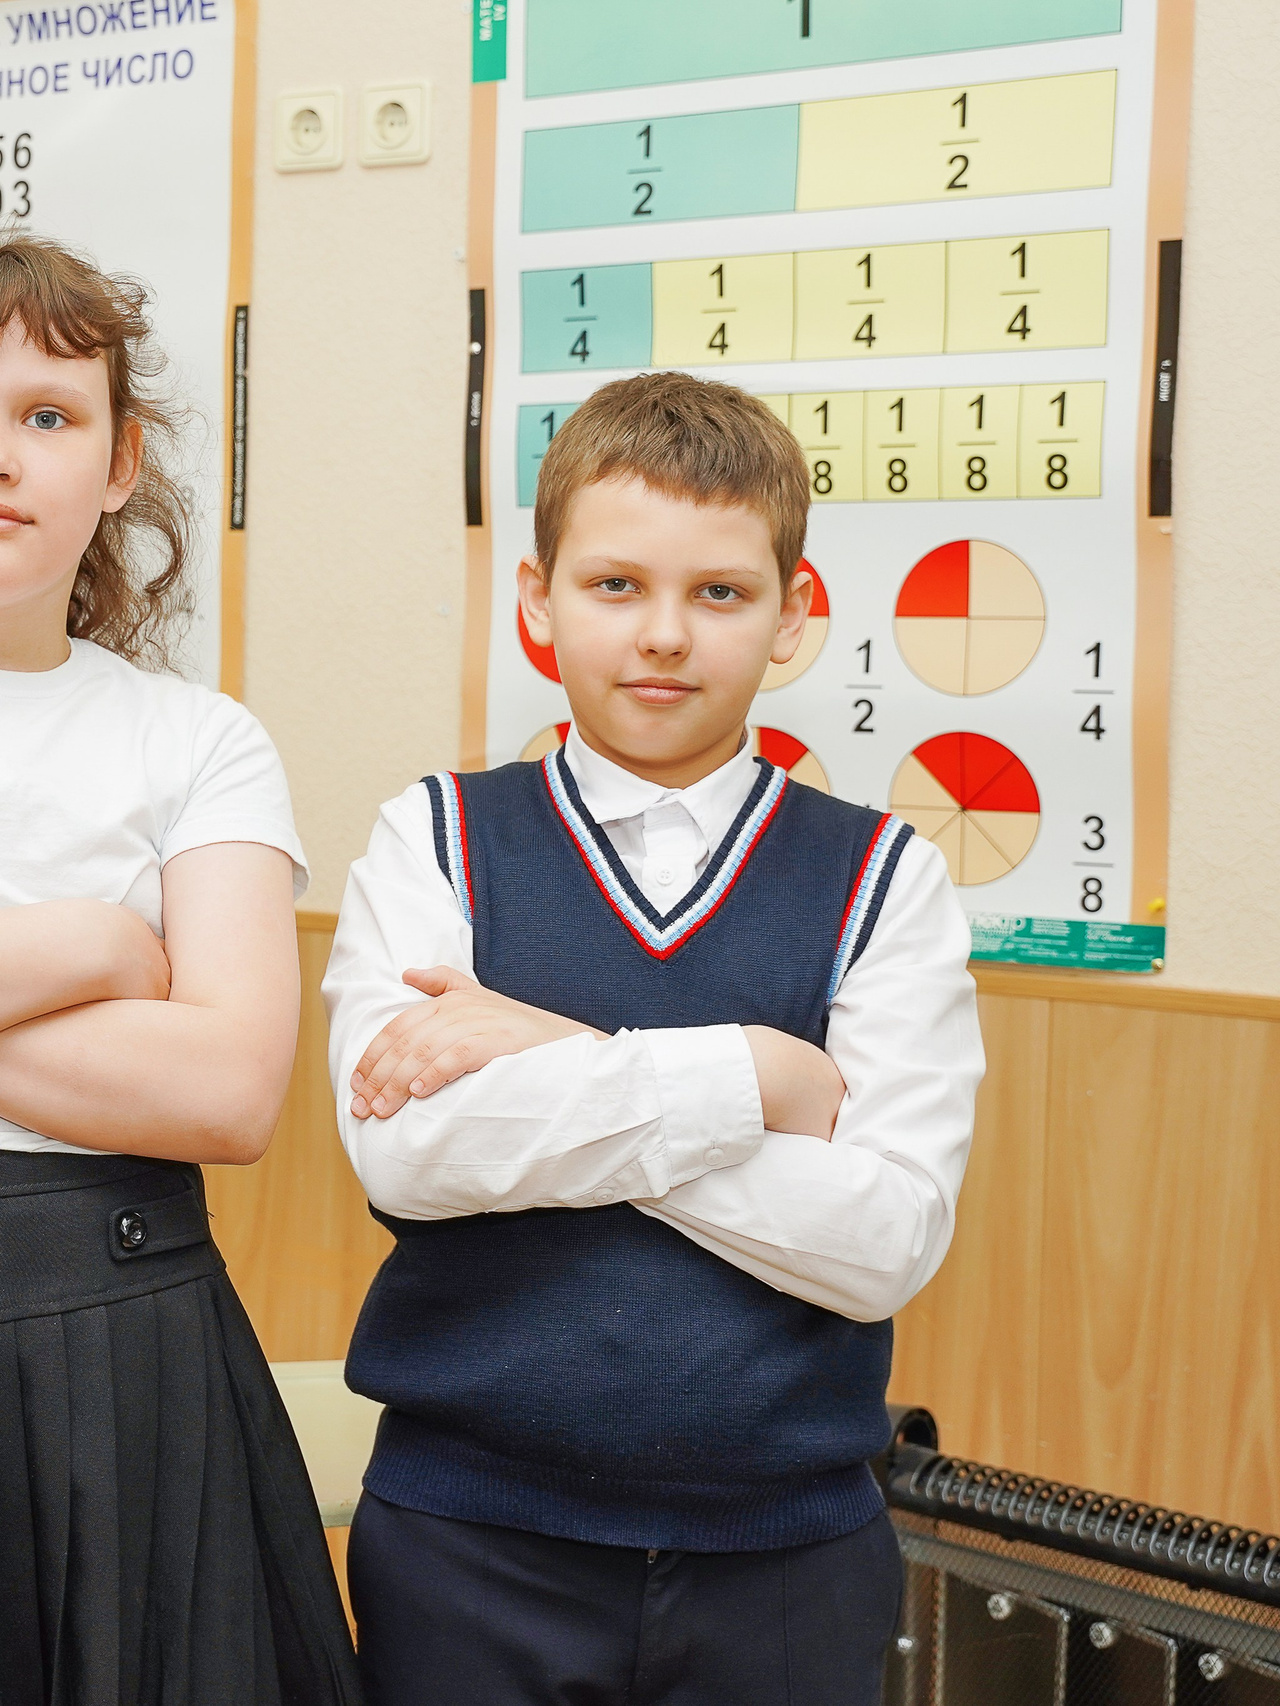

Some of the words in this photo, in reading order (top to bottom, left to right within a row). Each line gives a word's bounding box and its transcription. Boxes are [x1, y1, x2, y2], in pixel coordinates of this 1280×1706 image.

[6, 0, 217, 45] УМНОЖЕНИЕ
[82, 49, 194, 88] ЧИСЛО
[952, 92, 967, 128] 1
[637, 124, 652, 159] 1
[946, 154, 969, 190] 2
[632, 182, 653, 216] 2
[857, 253, 871, 289] 1
[1011, 241, 1026, 279] 1
[571, 273, 585, 307] 1
[710, 263, 724, 298] 1
[708, 322, 729, 356] 4
[853, 313, 877, 348] 4
[1006, 304, 1032, 341] 4
[569, 329, 590, 363] 4
[541, 411, 555, 442] 1
[814, 400, 829, 435] 1
[889, 397, 904, 433] 1
[969, 394, 985, 430] 1
[1050, 391, 1067, 427] 1
[812, 460, 833, 495] 8
[887, 458, 908, 494] 8
[966, 455, 988, 492] 8
[1046, 453, 1069, 491] 8
[857, 639, 871, 674] 1
[1085, 642, 1101, 678] 1
[853, 699, 874, 733] 2
[1080, 704, 1106, 741] 4
[1082, 815, 1106, 851] 3
[1080, 877, 1103, 913] 8
